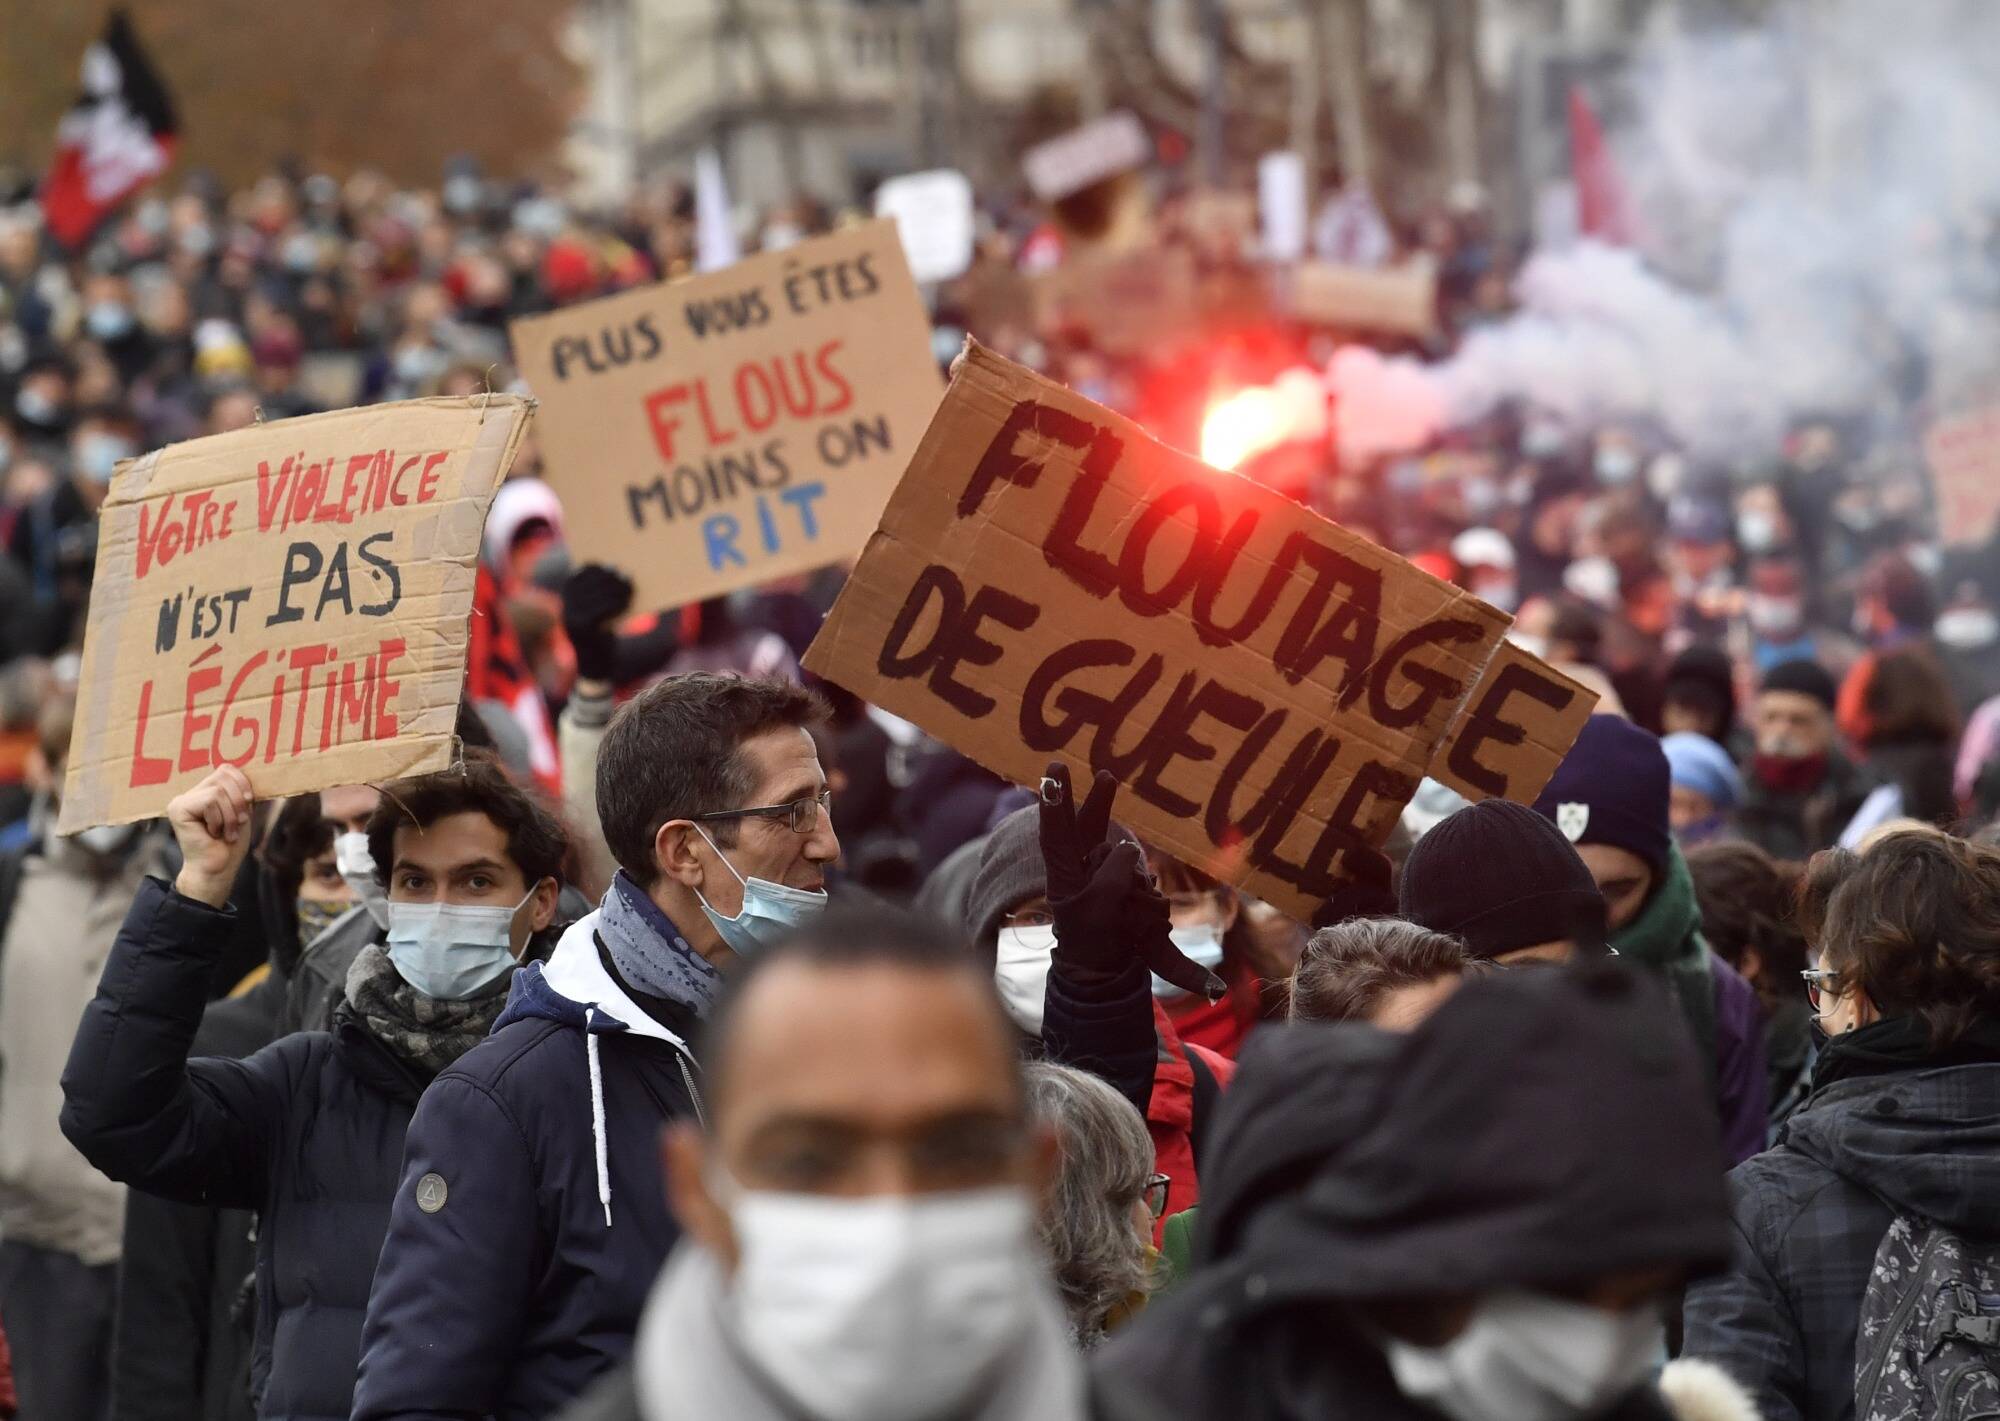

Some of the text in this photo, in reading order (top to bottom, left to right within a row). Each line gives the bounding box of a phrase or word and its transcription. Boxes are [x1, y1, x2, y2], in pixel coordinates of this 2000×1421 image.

[552, 252, 879, 380] PLUS VOUS ÊTES
[643, 339, 854, 462] FLOUS
[626, 414, 892, 529] MOINS ON
[703, 482, 825, 571] RIT
[136, 489, 237, 579] VOTRE
[155, 531, 401, 655] N'EST PAS
[957, 400, 1574, 796] FLOUTAGE
[877, 564, 1418, 896] DE GUEULE
